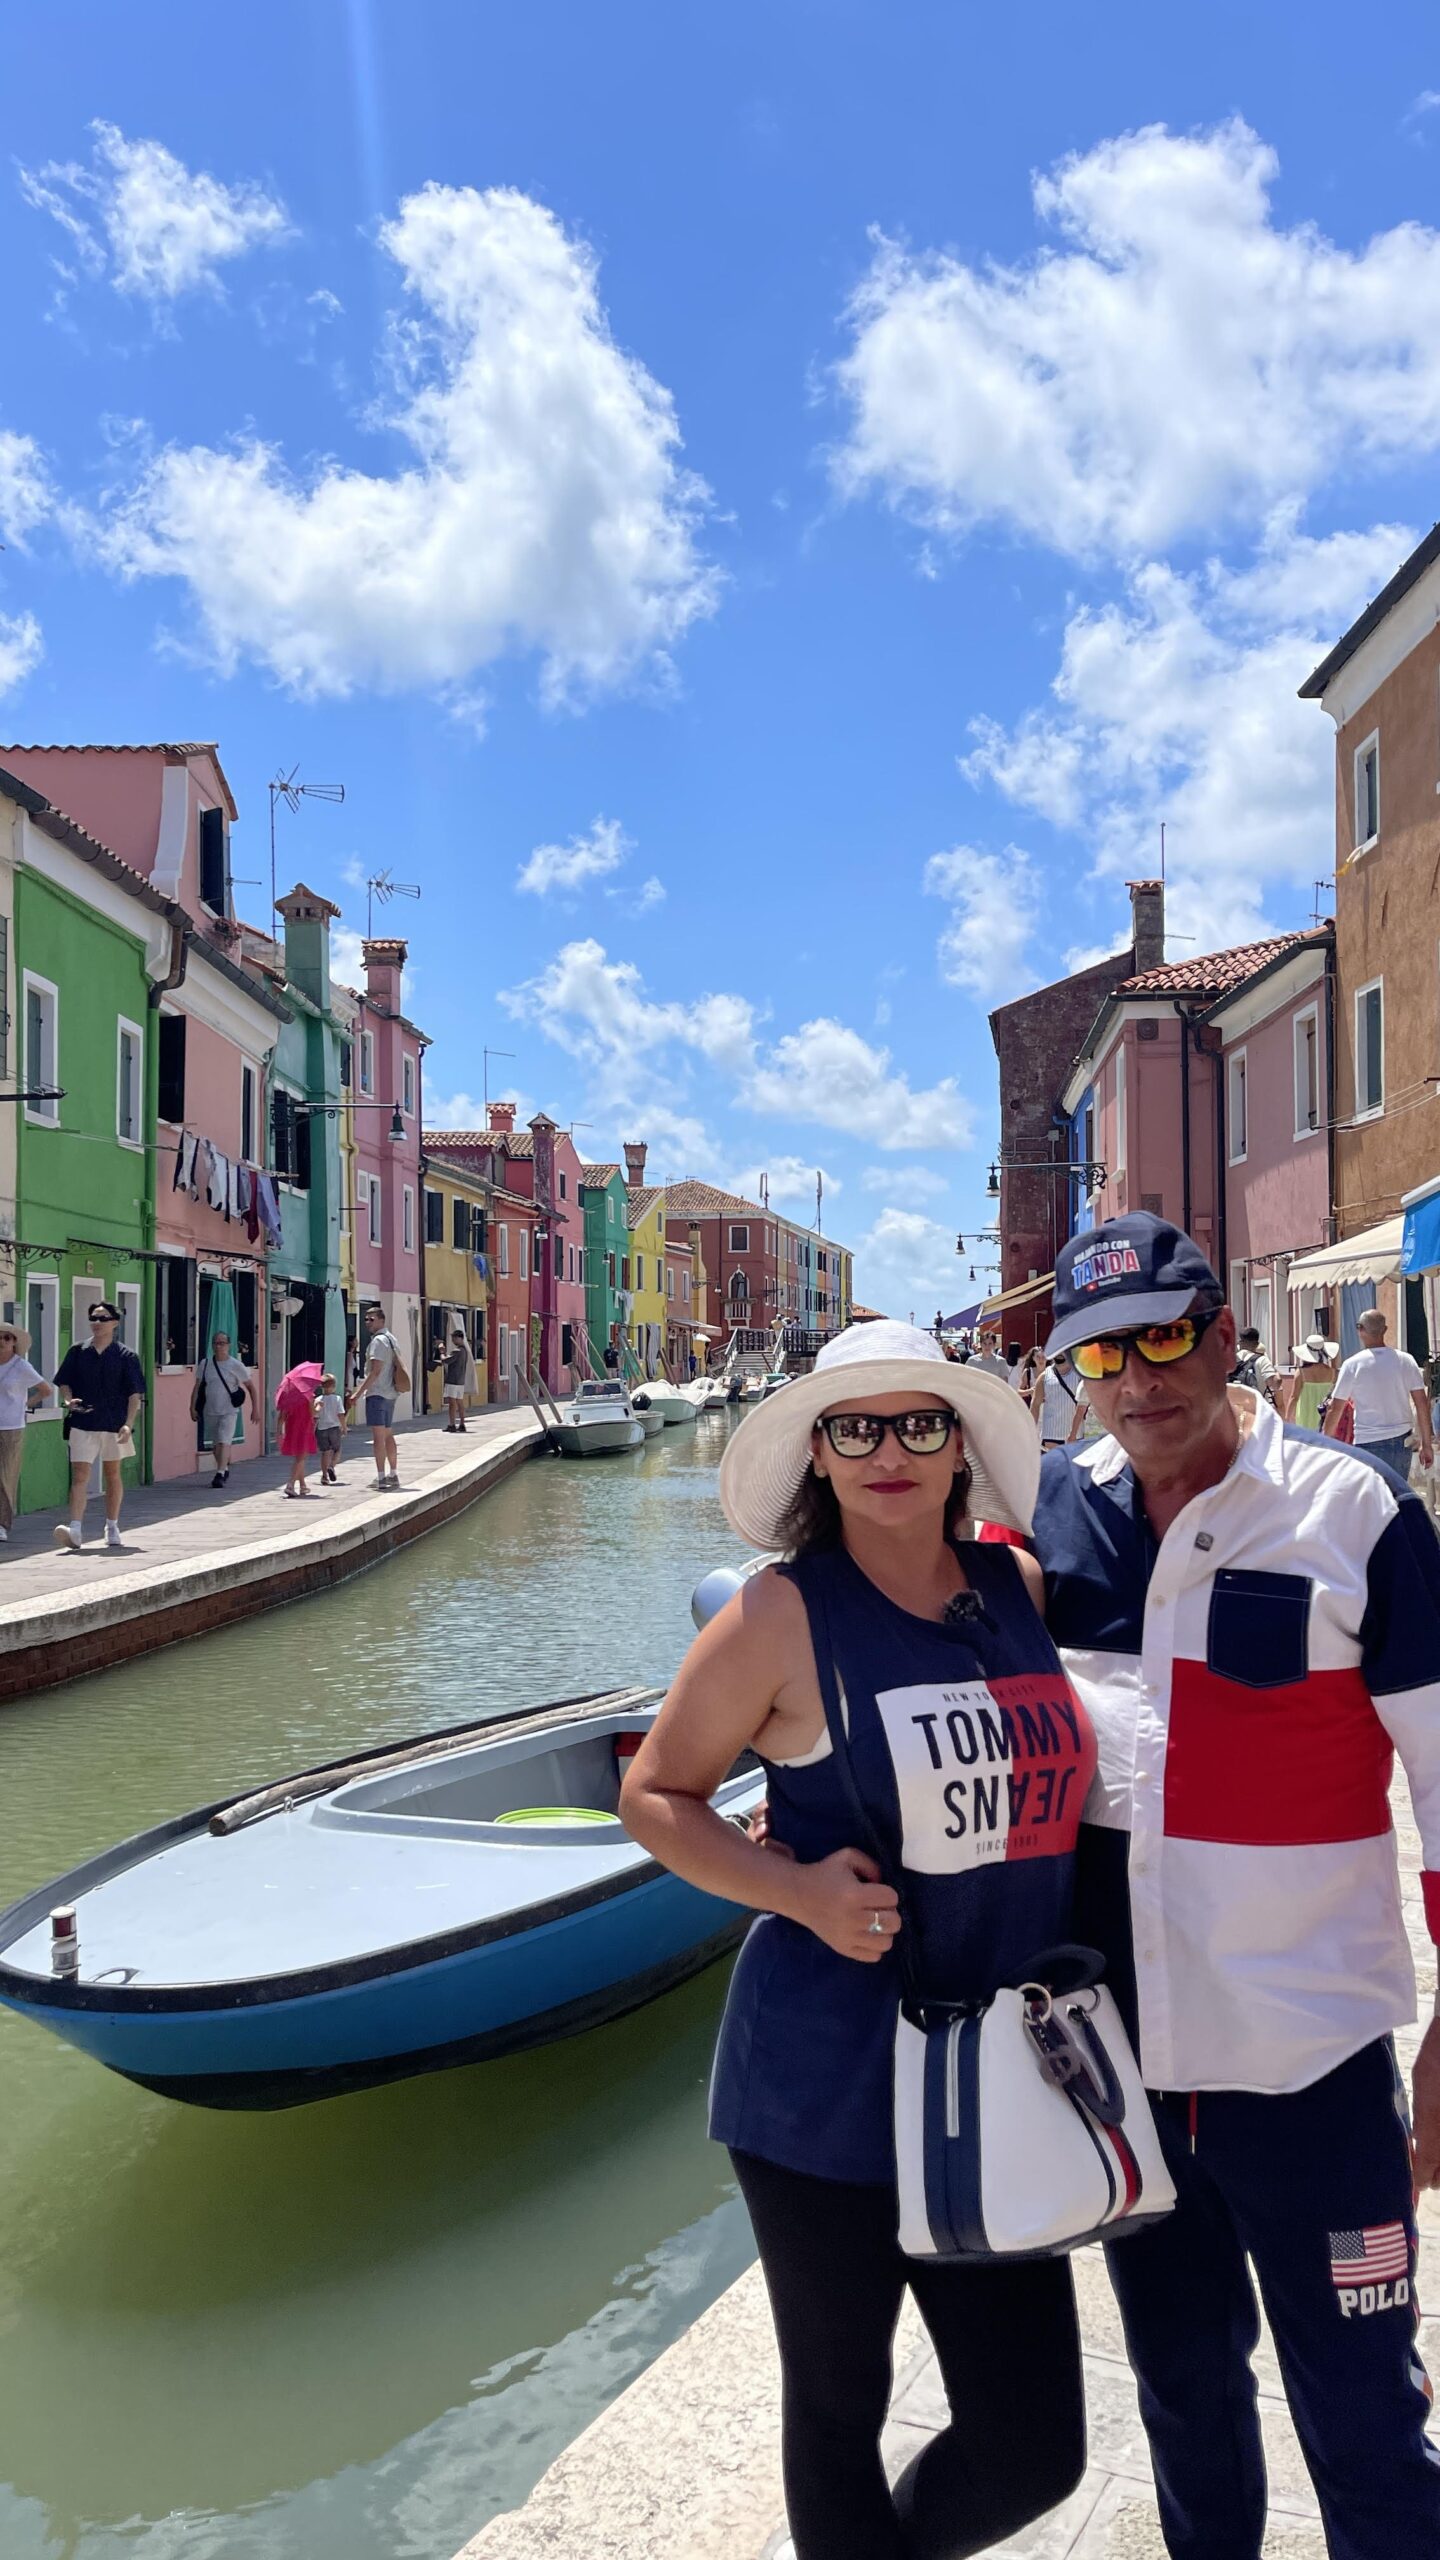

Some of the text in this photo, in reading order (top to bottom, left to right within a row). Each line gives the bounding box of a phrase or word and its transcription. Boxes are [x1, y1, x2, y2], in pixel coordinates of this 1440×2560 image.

[1111, 1240, 1130, 1251] CON
[1071, 1249, 1141, 1290] TANDA
[942, 1691, 970, 1703] NEW
[911, 1701, 1081, 1769] TOMMY
[976, 1838, 1008, 1856] SINCE
[1337, 2277, 1409, 2319] POLO
